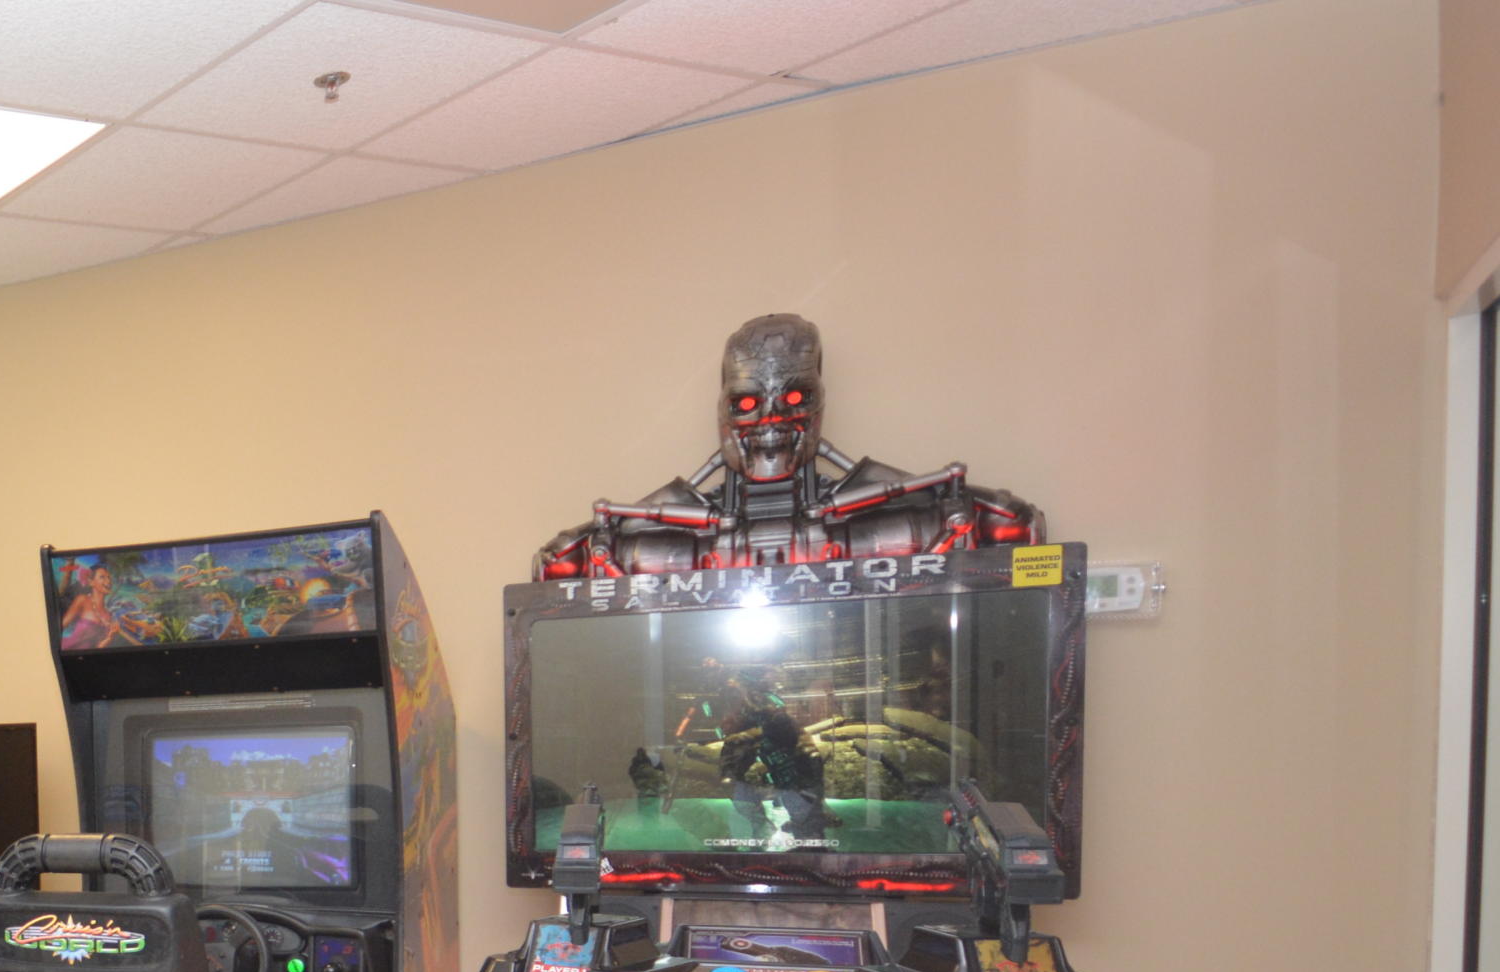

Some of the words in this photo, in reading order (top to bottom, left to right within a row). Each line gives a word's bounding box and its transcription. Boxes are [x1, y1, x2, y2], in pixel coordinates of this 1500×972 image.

[1014, 555, 1060, 563] ANIMATED
[1016, 563, 1059, 571] VIOLENCE
[558, 554, 947, 600] TERMINATOR
[591, 577, 896, 612] SALVATION
[12, 913, 130, 944] Cruis'n
